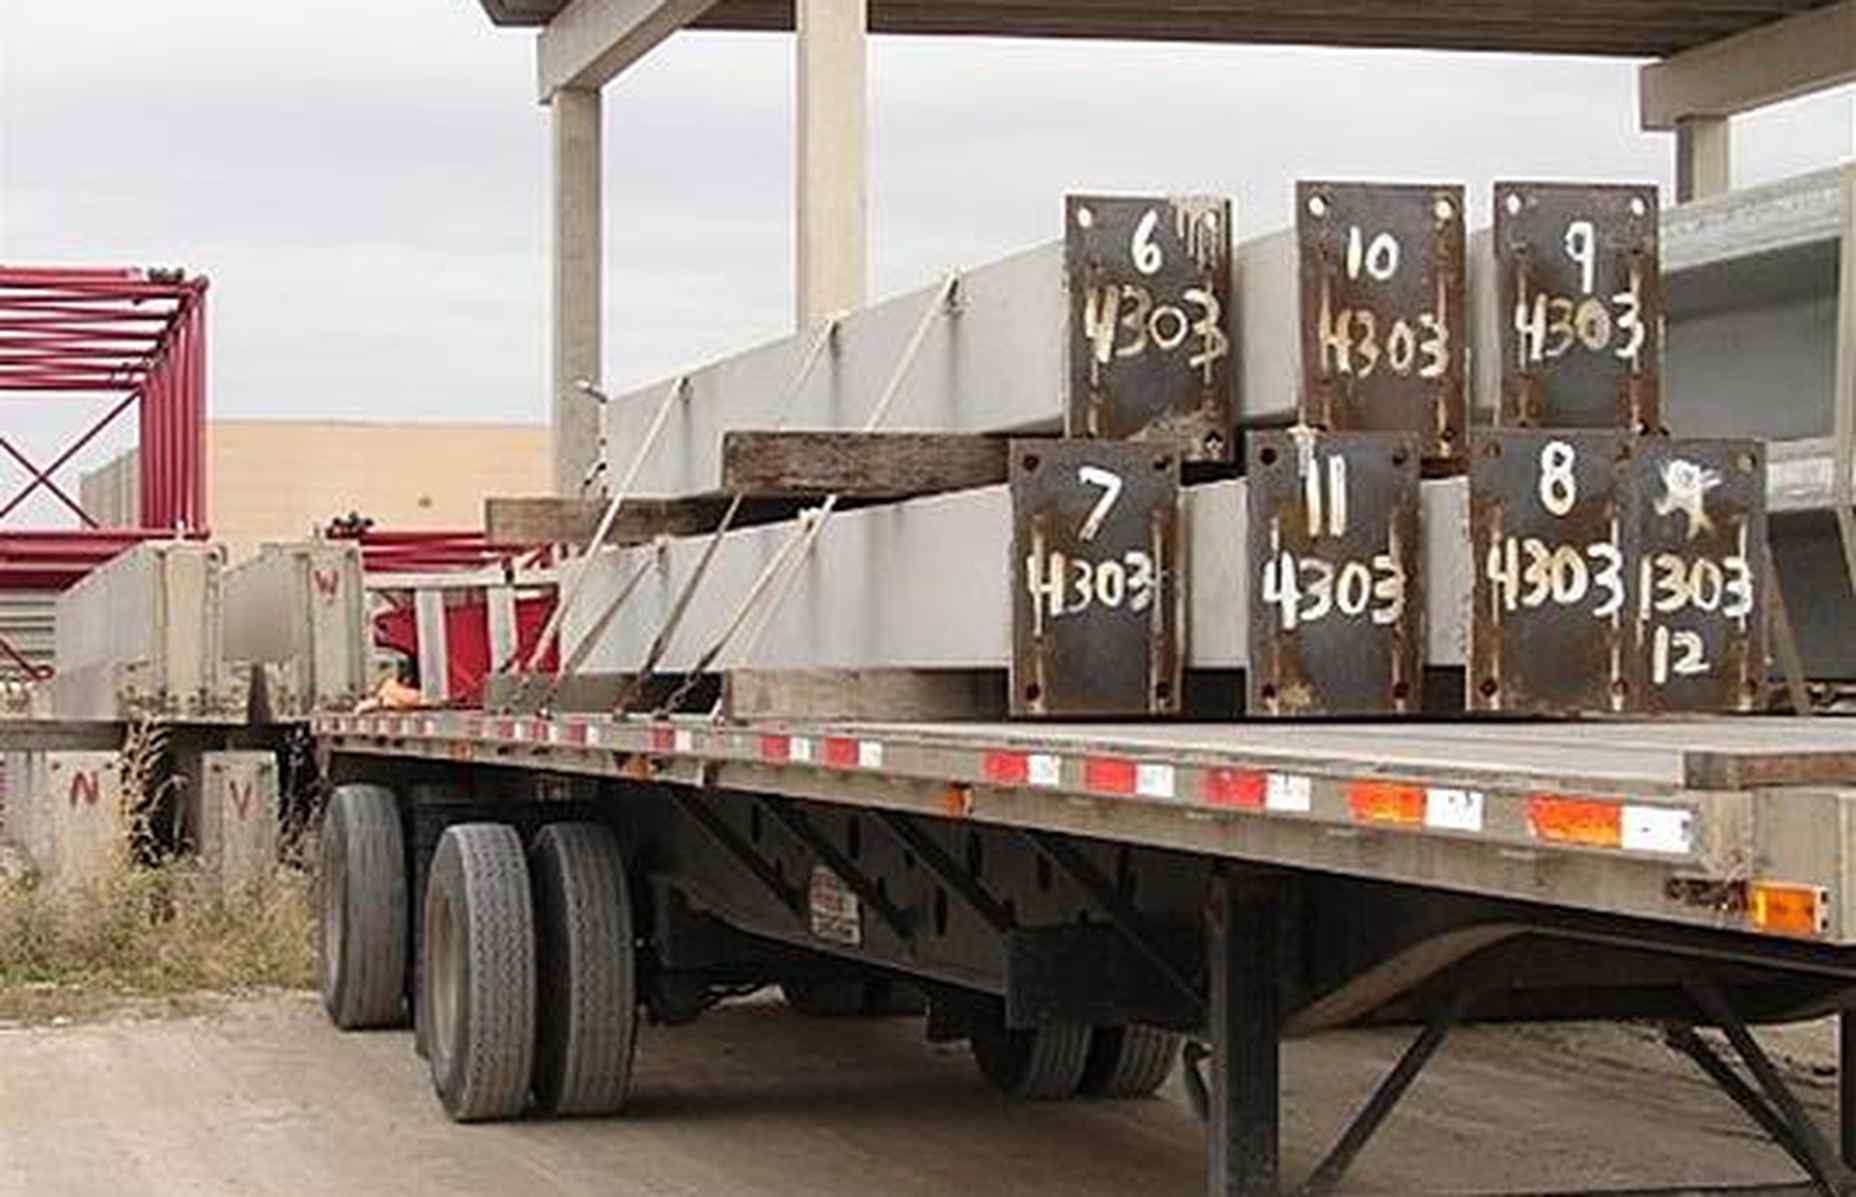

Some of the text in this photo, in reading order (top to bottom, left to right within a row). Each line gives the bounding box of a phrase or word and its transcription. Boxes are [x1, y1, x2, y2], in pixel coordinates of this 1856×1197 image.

[1131, 209, 1163, 274] 6
[1347, 226, 1400, 280] 10
[1566, 221, 1594, 294] 9
[1084, 284, 1229, 368] 4303
[1319, 308, 1449, 378] 4303
[1515, 293, 1645, 361] 4303
[1078, 466, 1122, 541] 7
[1307, 454, 1346, 537] 11
[1540, 441, 1577, 516] 8
[1027, 551, 1153, 616] 4303
[1263, 551, 1406, 630] 4303
[1487, 537, 1625, 618] 4303
[1653, 625, 1711, 684] 12
[70, 771, 98, 808] N
